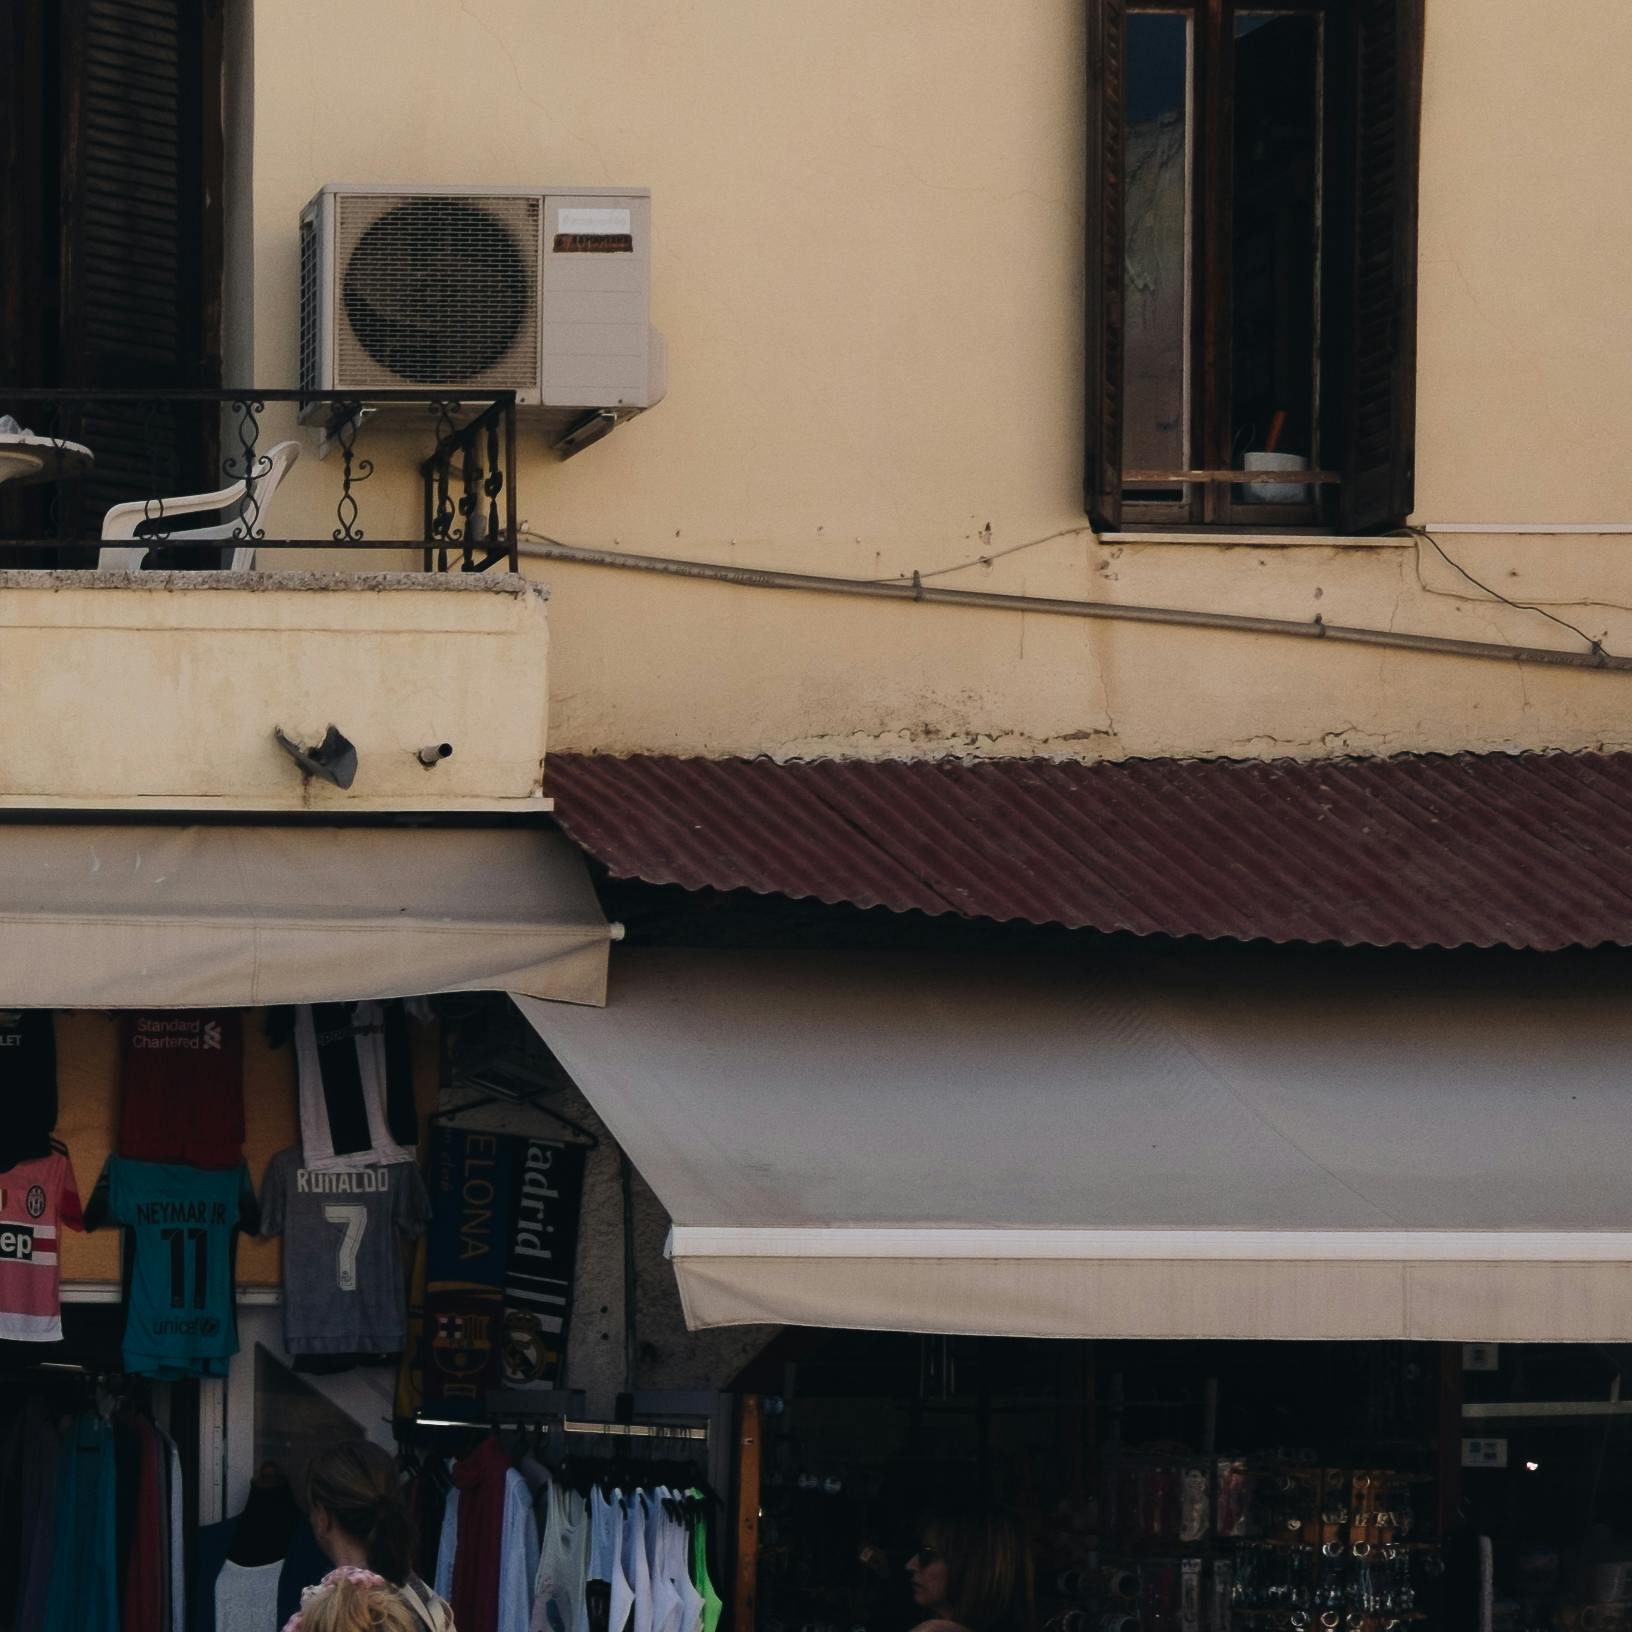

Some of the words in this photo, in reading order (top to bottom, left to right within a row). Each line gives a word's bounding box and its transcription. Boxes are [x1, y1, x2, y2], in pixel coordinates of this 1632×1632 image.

[137, 1017, 200, 1033] Standard
[132, 1034, 200, 1050] Chartered
[137, 1201, 208, 1225] NEYMAR
[211, 1202, 227, 1225] JR
[321, 1202, 368, 1292] 7
[160, 1227, 209, 1310] 11
